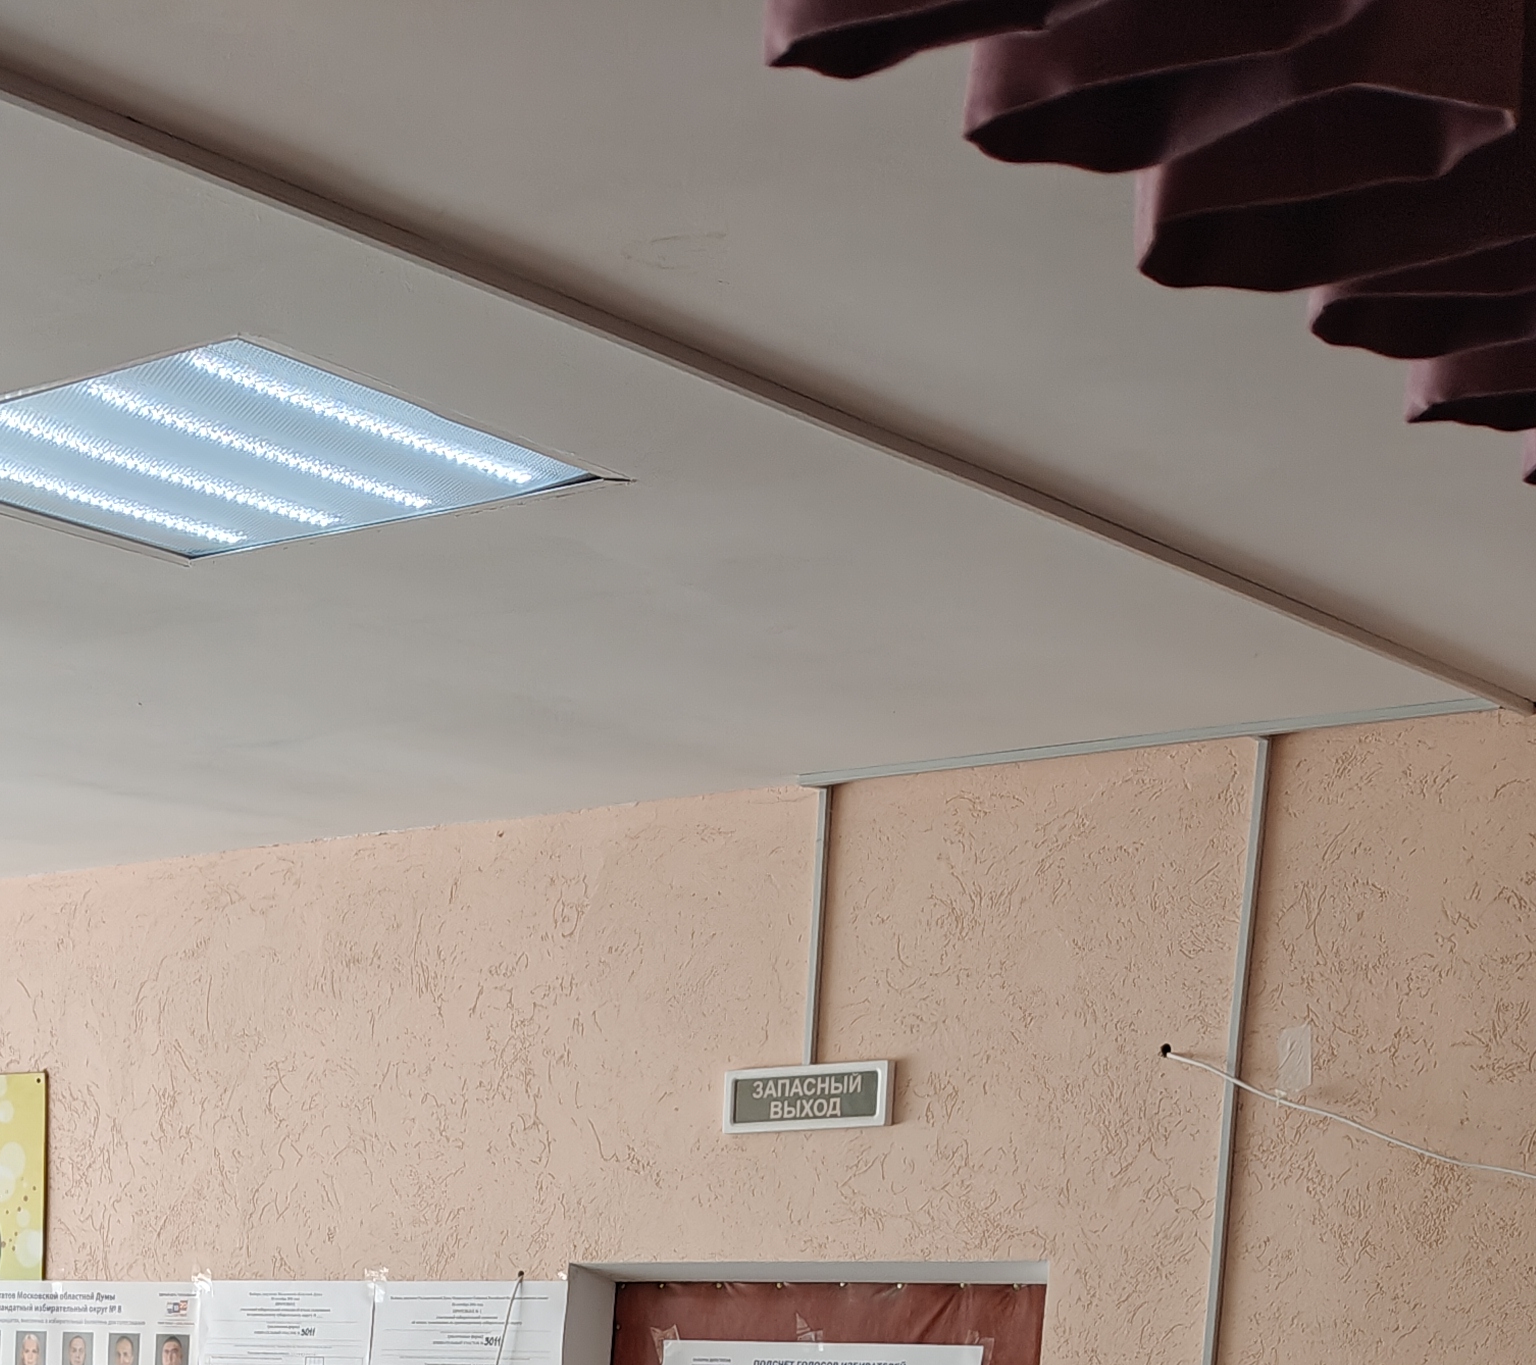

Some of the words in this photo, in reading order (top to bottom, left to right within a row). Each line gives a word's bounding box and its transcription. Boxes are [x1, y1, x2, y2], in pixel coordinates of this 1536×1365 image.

[752, 1073, 862, 1098] ЗАПАСНЫЙ
[769, 1098, 841, 1119] ВЫХОД
[17, 1290, 59, 1300] Московской
[60, 1291, 95, 1300] областной
[96, 1292, 116, 1302] Думы
[34, 1304, 88, 1313] избирательный
[89, 1305, 108, 1315] округ
[483, 1335, 501, 1347] 3011
